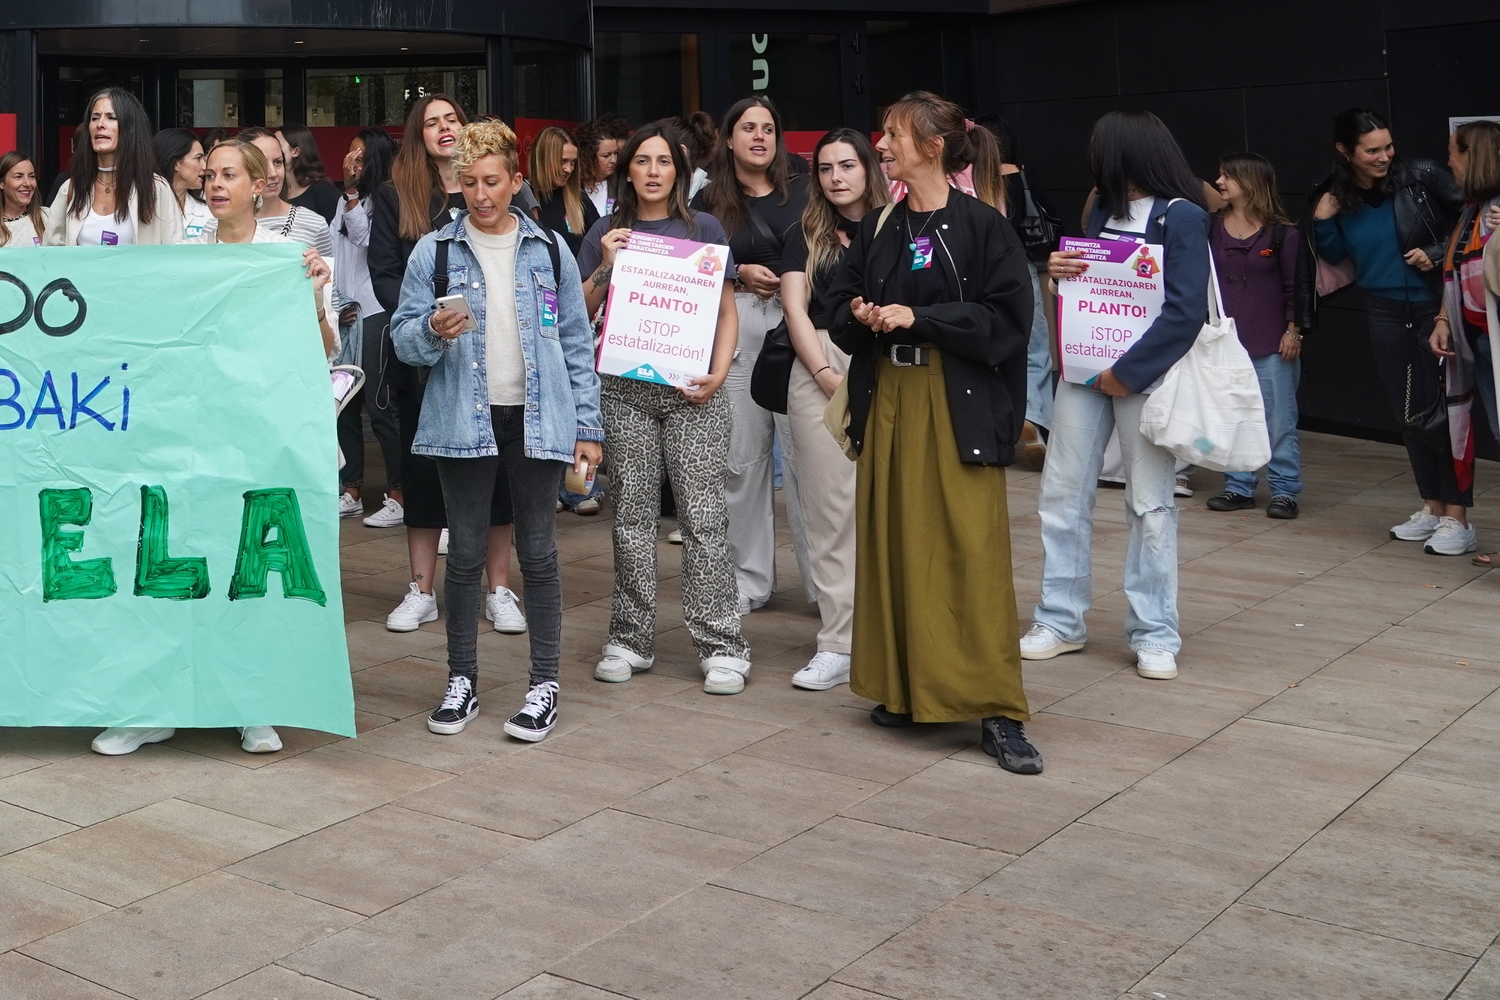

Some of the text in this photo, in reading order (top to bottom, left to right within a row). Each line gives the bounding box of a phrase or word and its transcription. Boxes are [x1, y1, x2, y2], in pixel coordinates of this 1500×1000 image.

[621, 265, 716, 288] ESTATALIZAZIOAREN
[1066, 275, 1157, 290] ESTATALIZAZIOAREN
[643, 280, 689, 296] AURREAN,
[1090, 288, 1135, 300] AURREAN,
[628, 291, 699, 315] PLANTO!
[1078, 300, 1147, 318] PLANTO!
[638, 319, 680, 338] ¡STOP
[1091, 326, 1133, 343] ¡STOP
[608, 333, 704, 362] estatalización!
[1065, 342, 1126, 360] estataliza
[637, 367, 655, 378] ELA
[37, 485, 328, 608] ELA
